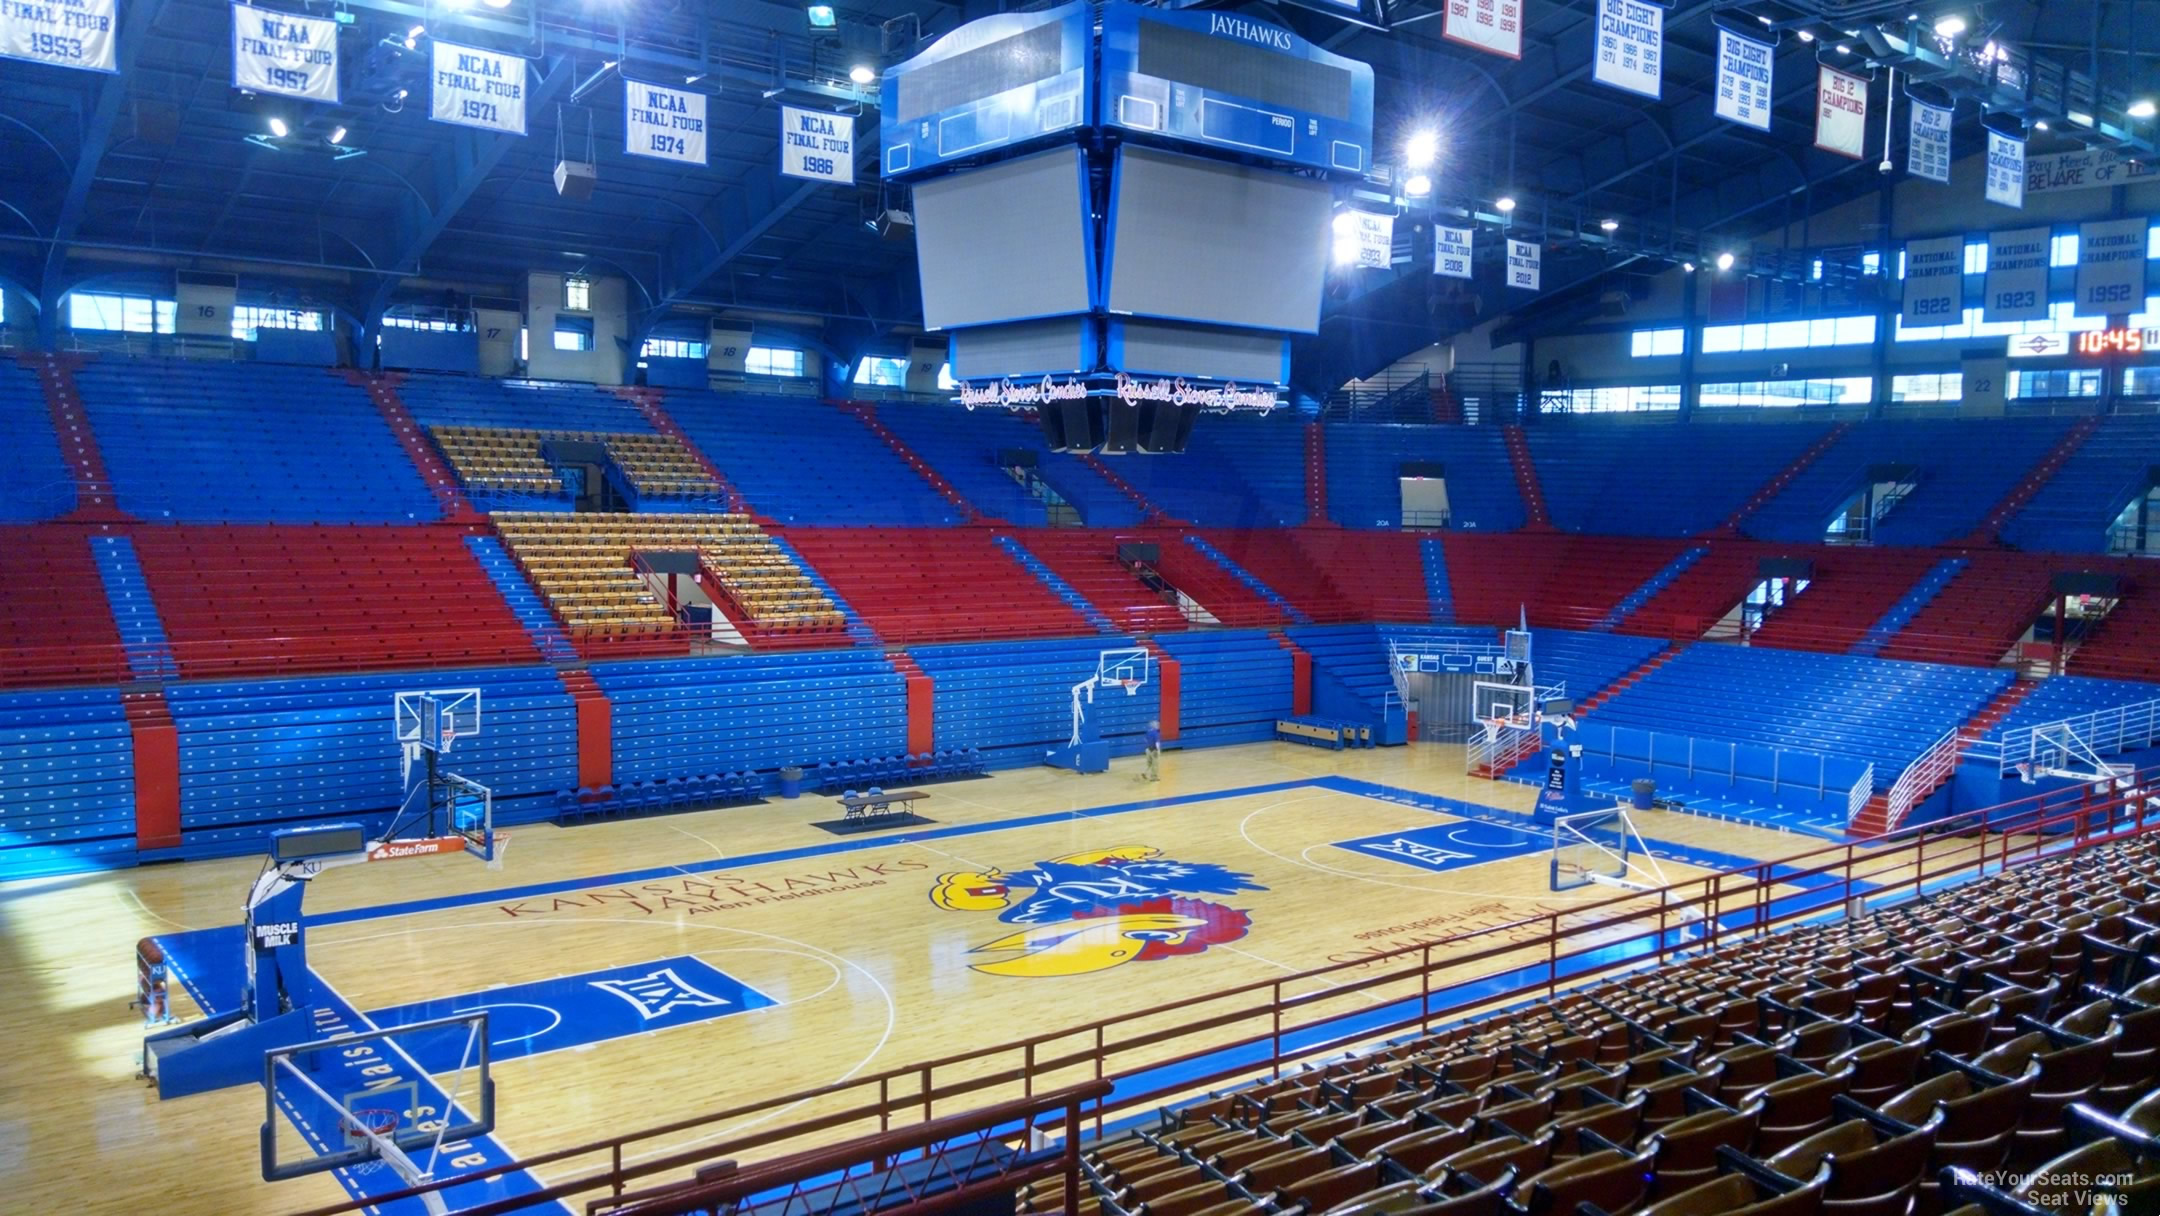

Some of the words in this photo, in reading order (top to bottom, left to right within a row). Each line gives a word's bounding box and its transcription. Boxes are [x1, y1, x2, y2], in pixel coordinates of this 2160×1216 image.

[1, 1, 57, 24] FINAL
[63, 10, 110, 32] FOUR
[1476, 11, 1493, 27] 1992
[1607, 0, 1623, 16] BIG
[1626, 3, 1655, 26] EIGHT
[262, 18, 311, 44] NCAA
[1209, 12, 1292, 50] JAYHAWKS
[1602, 13, 1658, 47] CHAMPIONS
[31, 32, 82, 59] 1953
[241, 37, 288, 60] FINAL
[294, 47, 333, 66] FOUR
[1726, 37, 1740, 56] BIG
[1743, 43, 1767, 65] EIGHT
[457, 53, 503, 78] NCAA
[1723, 54, 1769, 84] CHAMPIONS
[266, 66, 309, 91] 1957
[438, 70, 480, 92] FINAL
[485, 79, 521, 99] FOUR
[1832, 75, 1845, 93] BIG
[462, 99, 498, 122] 1971
[648, 91, 687, 113] NCAA
[1823, 88, 1863, 115] CHAMPIONS
[631, 108, 668, 127] FINAL
[672, 114, 703, 133] FOUR
[800, 115, 835, 136] NCAA
[1271, 116, 1292, 128] PERIOD
[651, 133, 685, 155] 1974
[786, 131, 820, 150] FINAL
[823, 138, 850, 154] FOUR
[803, 155, 834, 175] 1986
[2028, 168, 2086, 192] BEWARE
[2095, 165, 2117, 180] OF
[1444, 230, 1463, 244] NCAA
[2087, 233, 2139, 248] NATIONAL
[1437, 242, 1455, 255] FINAL
[1455, 246, 1470, 257] FOUR
[1516, 244, 1532, 258] NCAA
[1912, 251, 1957, 265] NATIONAL
[1995, 242, 2043, 257] NATIONAL
[2081, 248, 2144, 264] CHAMPIONS
[1508, 256, 1525, 268] FINAL
[1525, 259, 1539, 270] FOUR
[1907, 264, 1960, 279] CHAMPIONS
[1989, 257, 2047, 272] CHAMPIONS
[1516, 272, 1531, 285] 2012
[1995, 290, 2036, 309] 1923
[2088, 283, 2132, 304] 1952
[198, 306, 215, 318] 16
[1913, 297, 1950, 316] 1922
[487, 328, 501, 339] 17
[2079, 328, 2141, 353] 10:45
[960, 380, 999, 410] Russell
[1000, 377, 1041, 406] Stover
[1042, 375, 1087, 403] Candies
[1115, 372, 1171, 406] Russell
[1974, 379, 1991, 392] 22
[303, 861, 322, 874] KU
[498, 873, 745, 917] KANSAS
[630, 859, 929, 915] JAYHAWKS
[688, 898, 748, 916] Allen
[754, 878, 887, 909] Fieldhouse
[256, 922, 298, 938] MUSCLE
[264, 935, 291, 948] MILK
